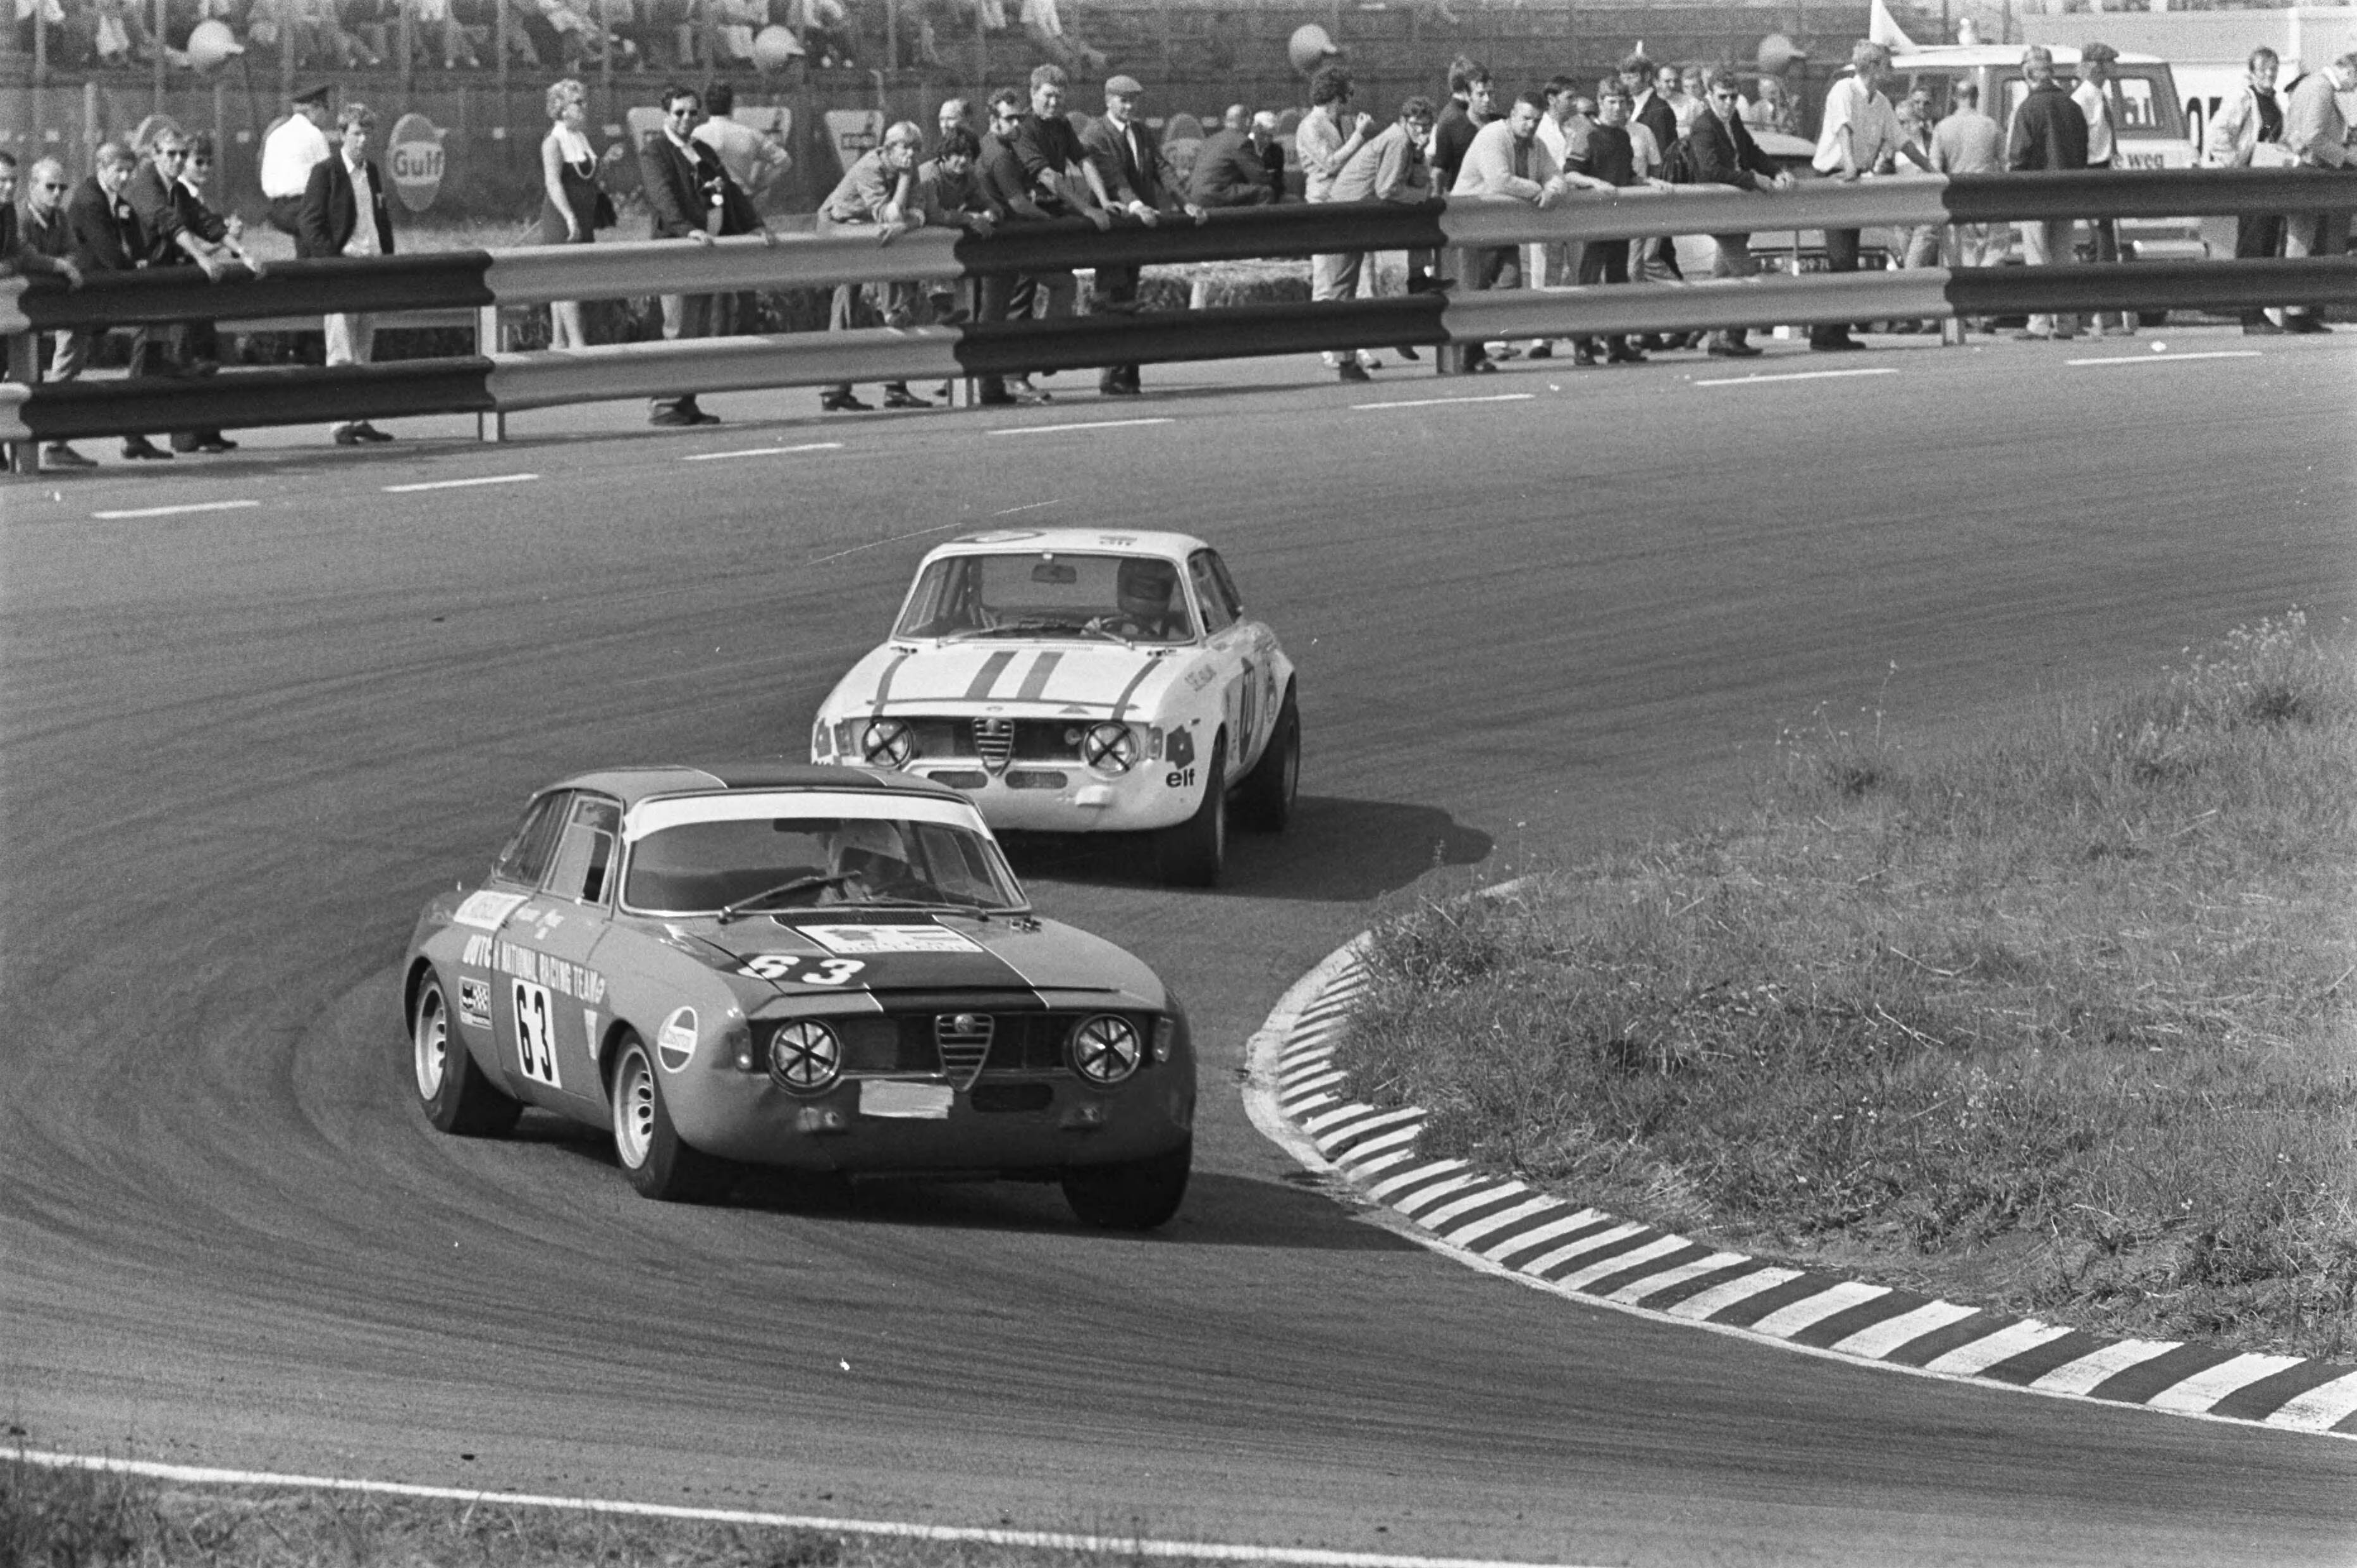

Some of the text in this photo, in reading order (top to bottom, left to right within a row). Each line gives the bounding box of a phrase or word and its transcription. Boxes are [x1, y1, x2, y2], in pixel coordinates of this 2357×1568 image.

[393, 149, 442, 178] Gulf
[1165, 768, 1196, 788] elf
[462, 934, 501, 972] DUTCH
[539, 953, 572, 996] RACING
[736, 955, 867, 985] 63
[516, 984, 552, 1082] 63
